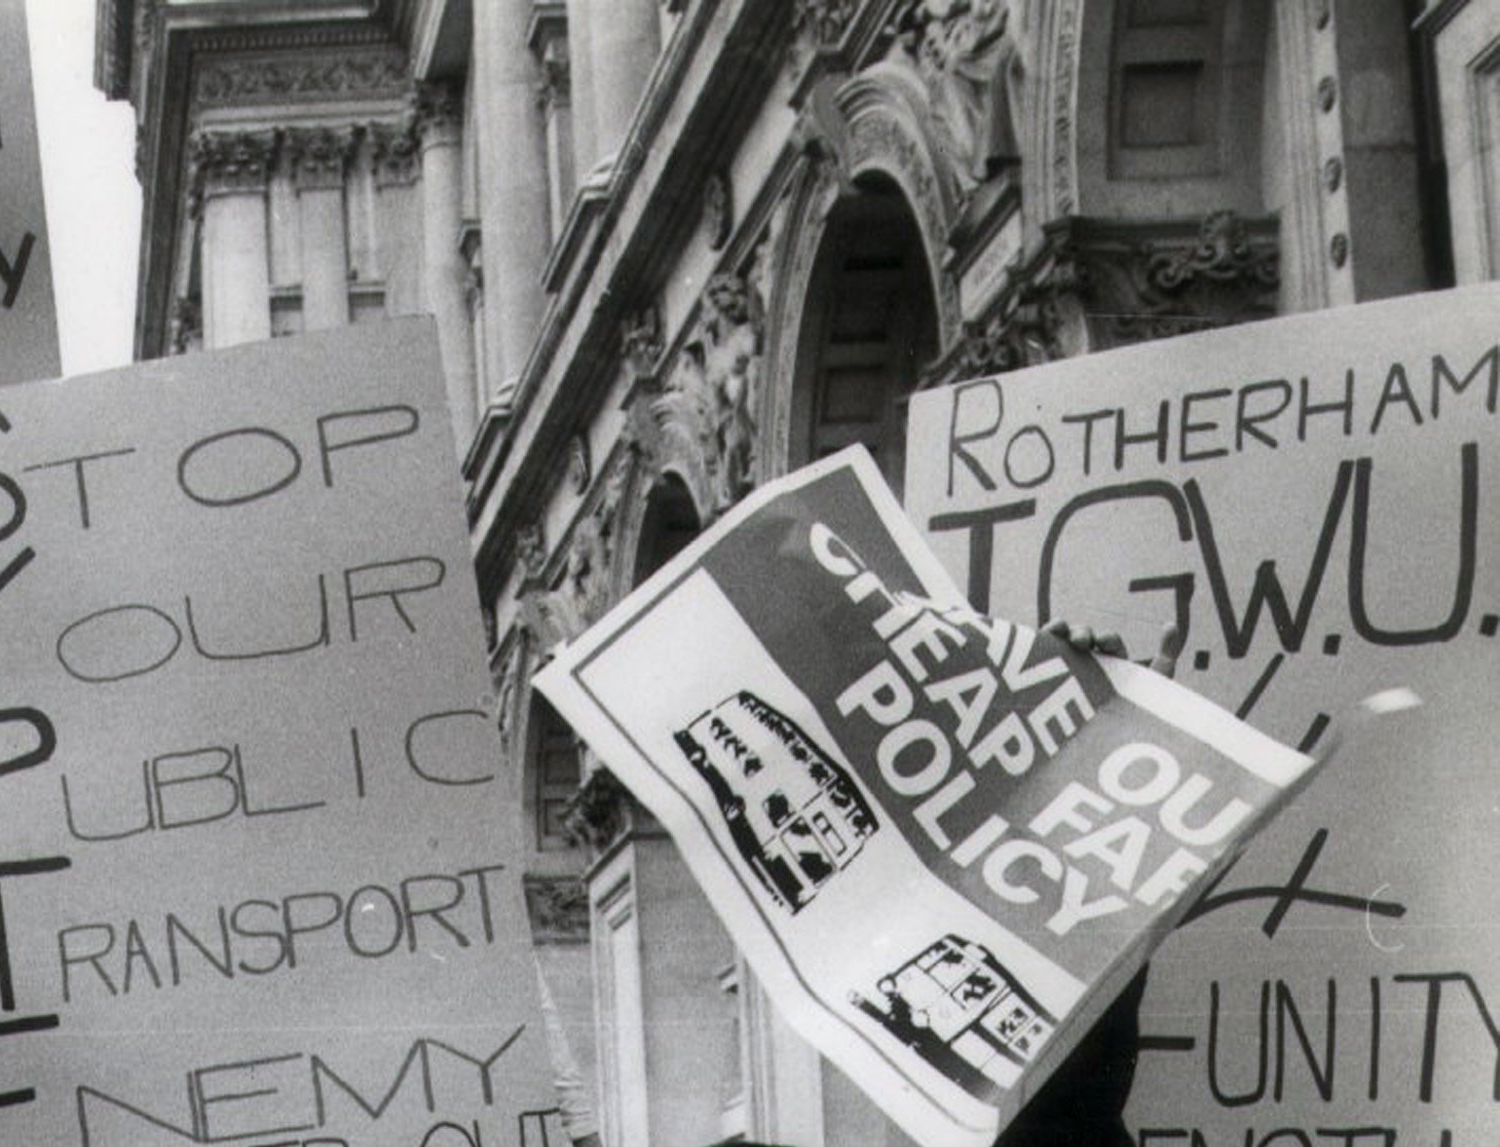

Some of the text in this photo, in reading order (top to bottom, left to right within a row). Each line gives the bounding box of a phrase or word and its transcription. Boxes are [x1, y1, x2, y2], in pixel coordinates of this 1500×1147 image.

[946, 345, 1500, 498] ROTHERHAM
[836, 659, 1130, 937] POLICY
[1097, 741, 1252, 847] OU
